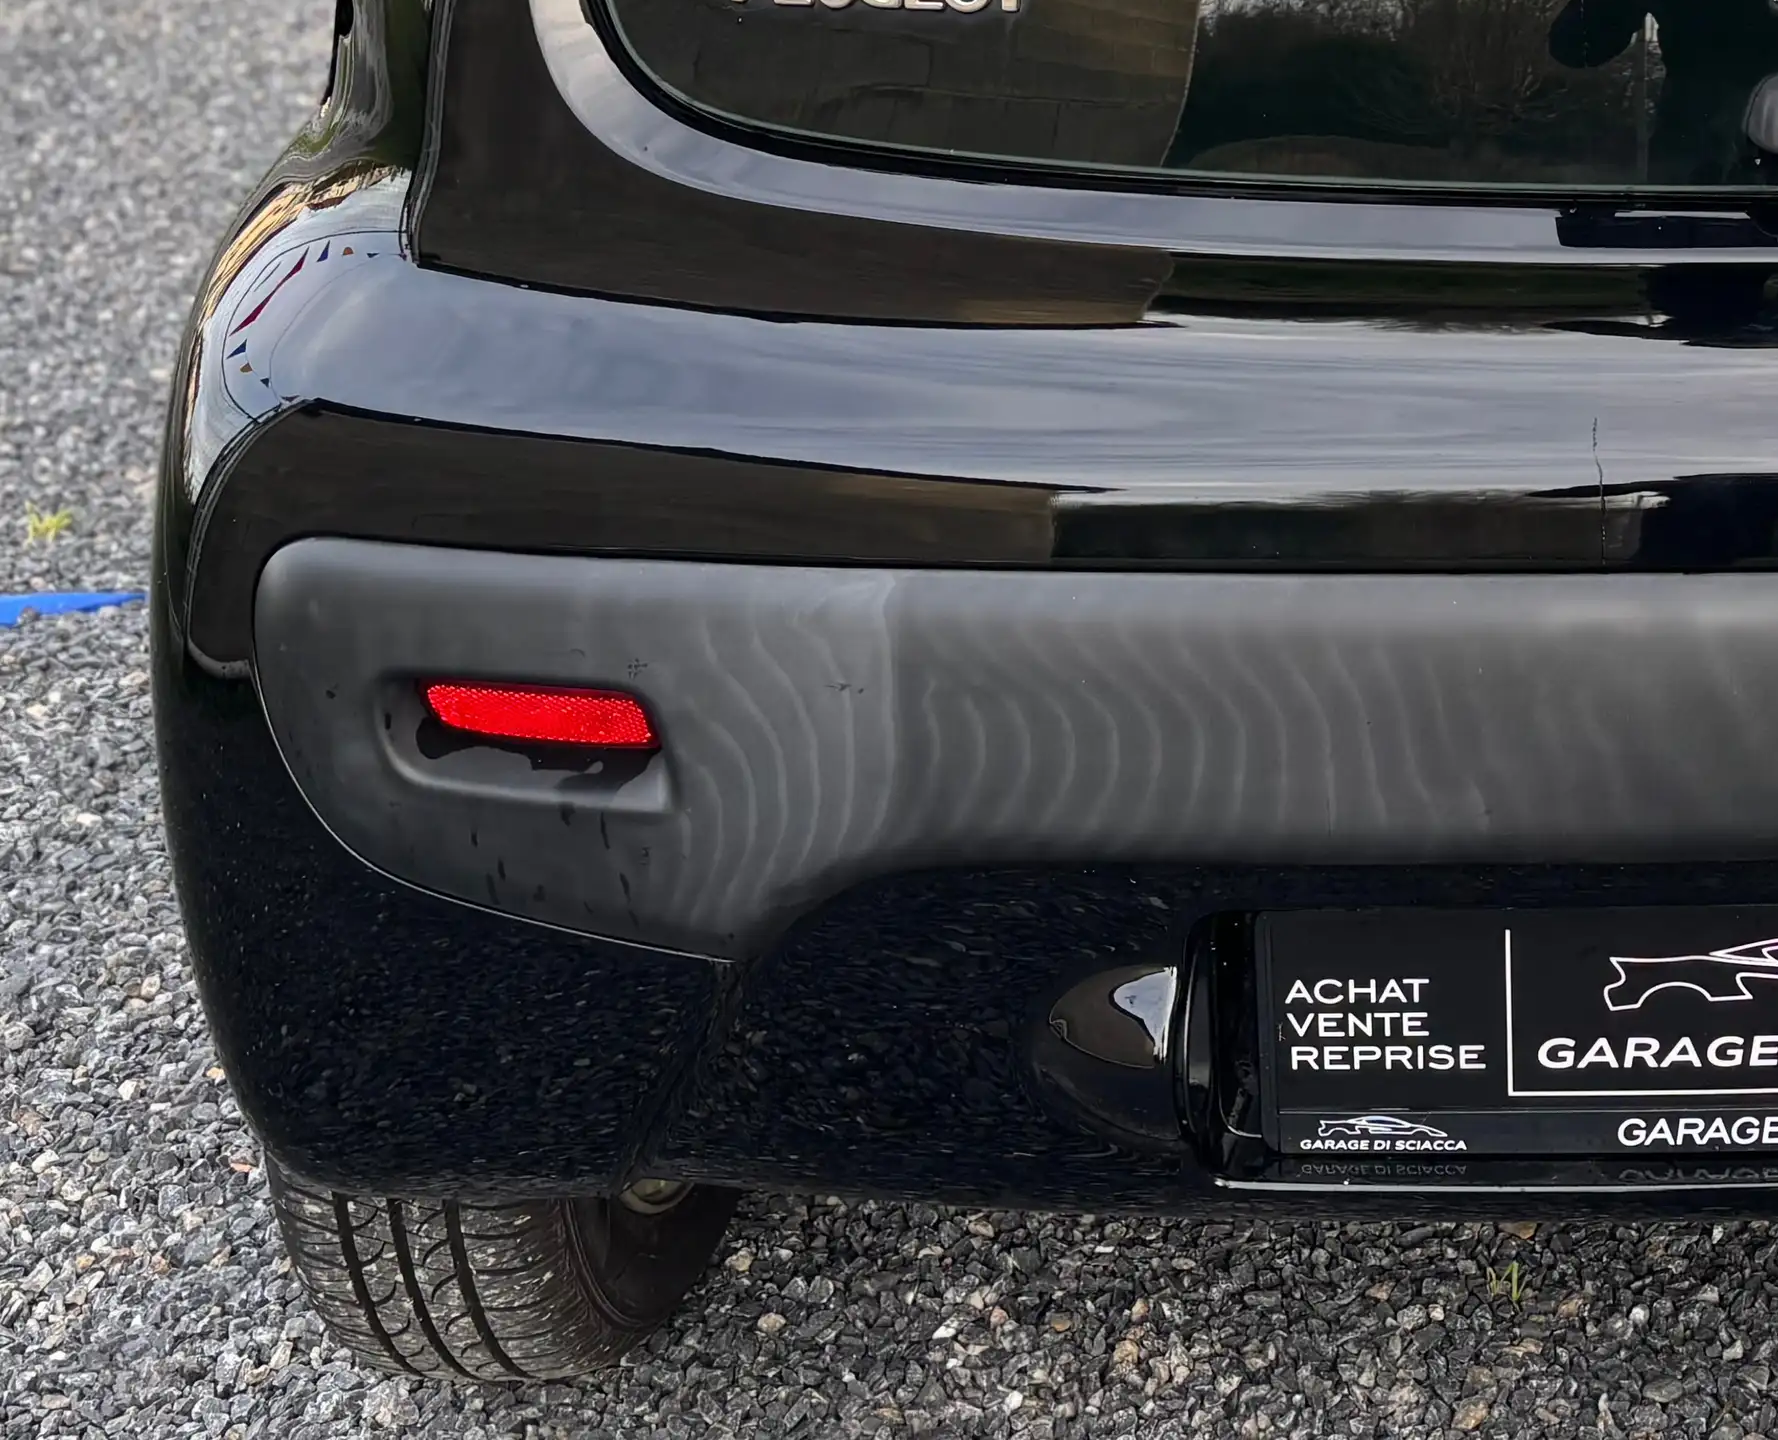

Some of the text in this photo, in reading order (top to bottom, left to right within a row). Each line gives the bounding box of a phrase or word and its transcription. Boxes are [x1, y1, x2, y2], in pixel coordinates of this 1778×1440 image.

[1284, 978, 1430, 1005] ACHAT
[1284, 1011, 1430, 1038] VENTE
[1290, 1044, 1487, 1071] REPRISE
[1300, 1139, 1468, 1151] GARAGE DI SCIACCA
